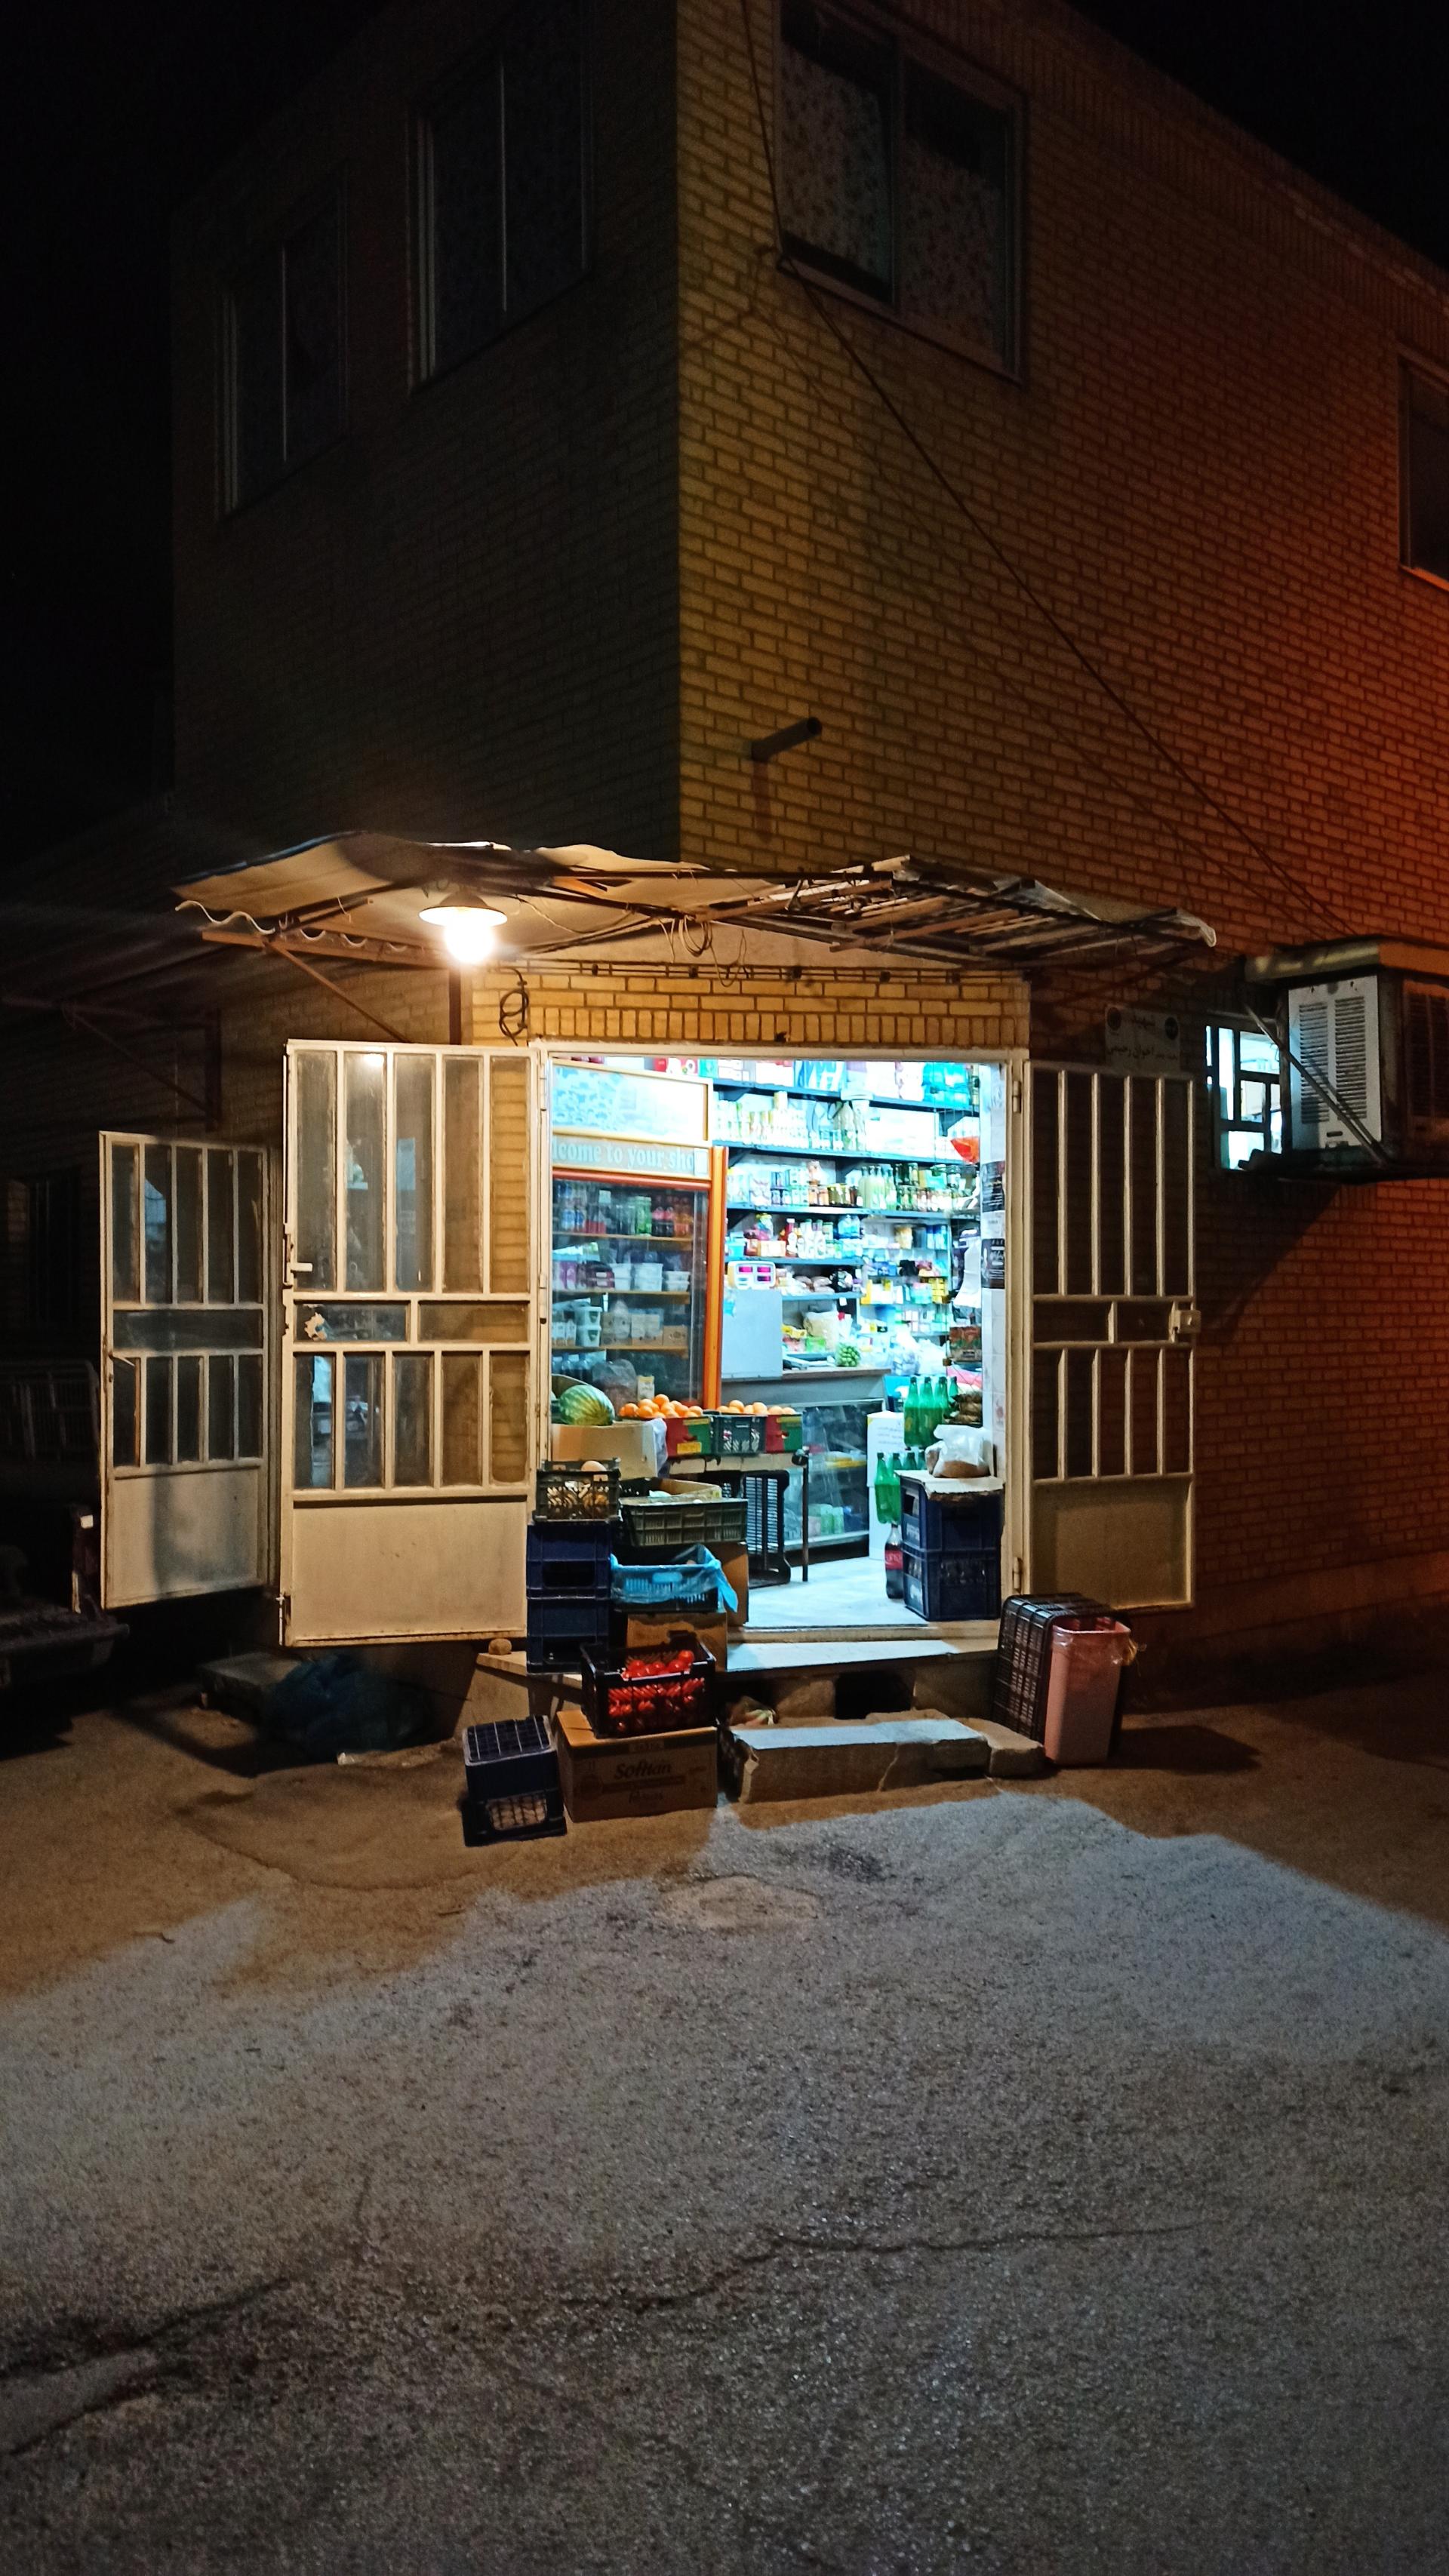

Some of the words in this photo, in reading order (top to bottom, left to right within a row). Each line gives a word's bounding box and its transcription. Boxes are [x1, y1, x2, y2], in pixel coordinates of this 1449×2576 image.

[552, 1136, 601, 1163] lcome
[607, 1141, 623, 1164] to
[627, 1147, 665, 1168] your
[669, 1148, 694, 1170] sho
